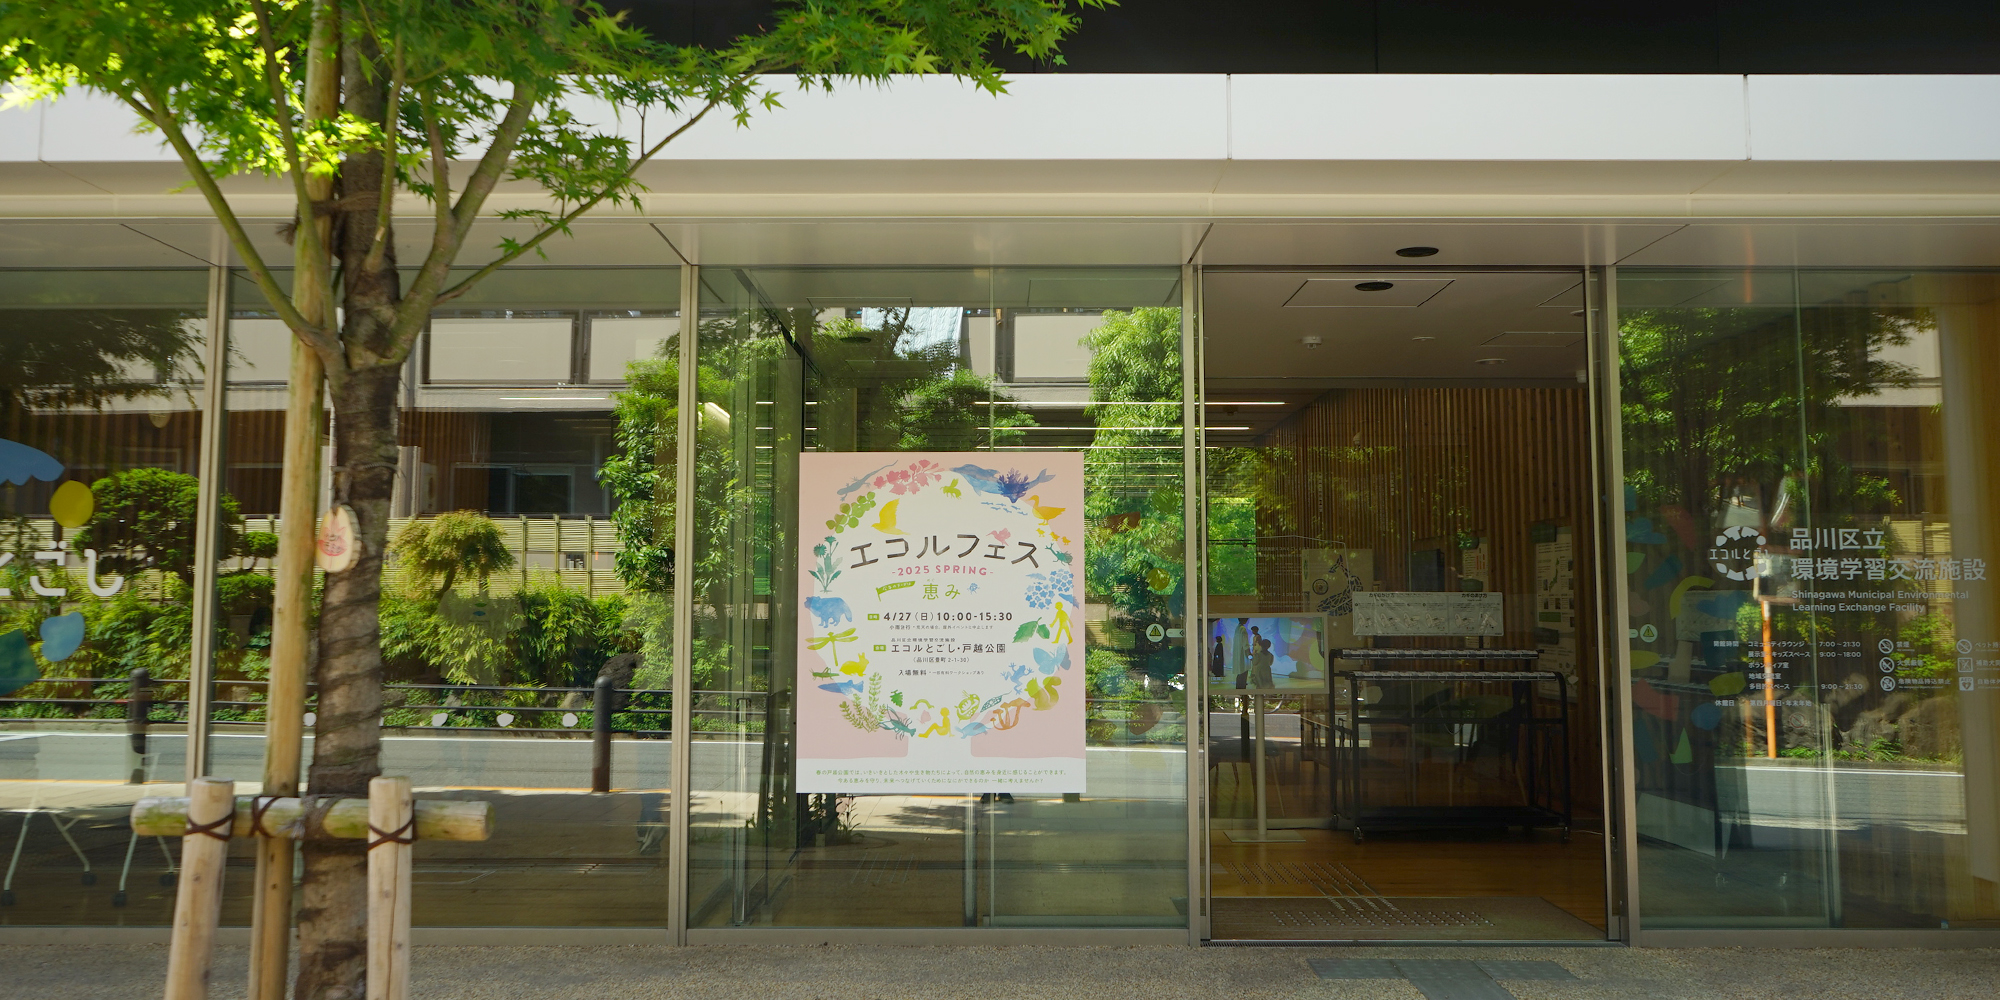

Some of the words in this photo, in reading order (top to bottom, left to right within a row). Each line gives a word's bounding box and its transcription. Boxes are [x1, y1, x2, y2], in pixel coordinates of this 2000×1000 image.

[1789, 527, 1886, 550] 品川区立
[850, 534, 1039, 569] エコルフェス
[1709, 547, 1774, 560] エコルとごし
[891, 565, 930, 576] -2025
[1790, 558, 1987, 581] 環境学習交流施設
[922, 583, 961, 600] 恵み
[1791, 590, 1846, 600] Shinagawa
[1848, 590, 1895, 600] Municipal
[1897, 591, 1969, 600] Environmental
[1792, 603, 1836, 613] Learning
[1839, 603, 1886, 613] Exchange
[1889, 603, 1925, 613] Facility
[891, 643, 1006, 654] エコルとごし・戸越公園
[1714, 699, 1735, 707] 休館日
